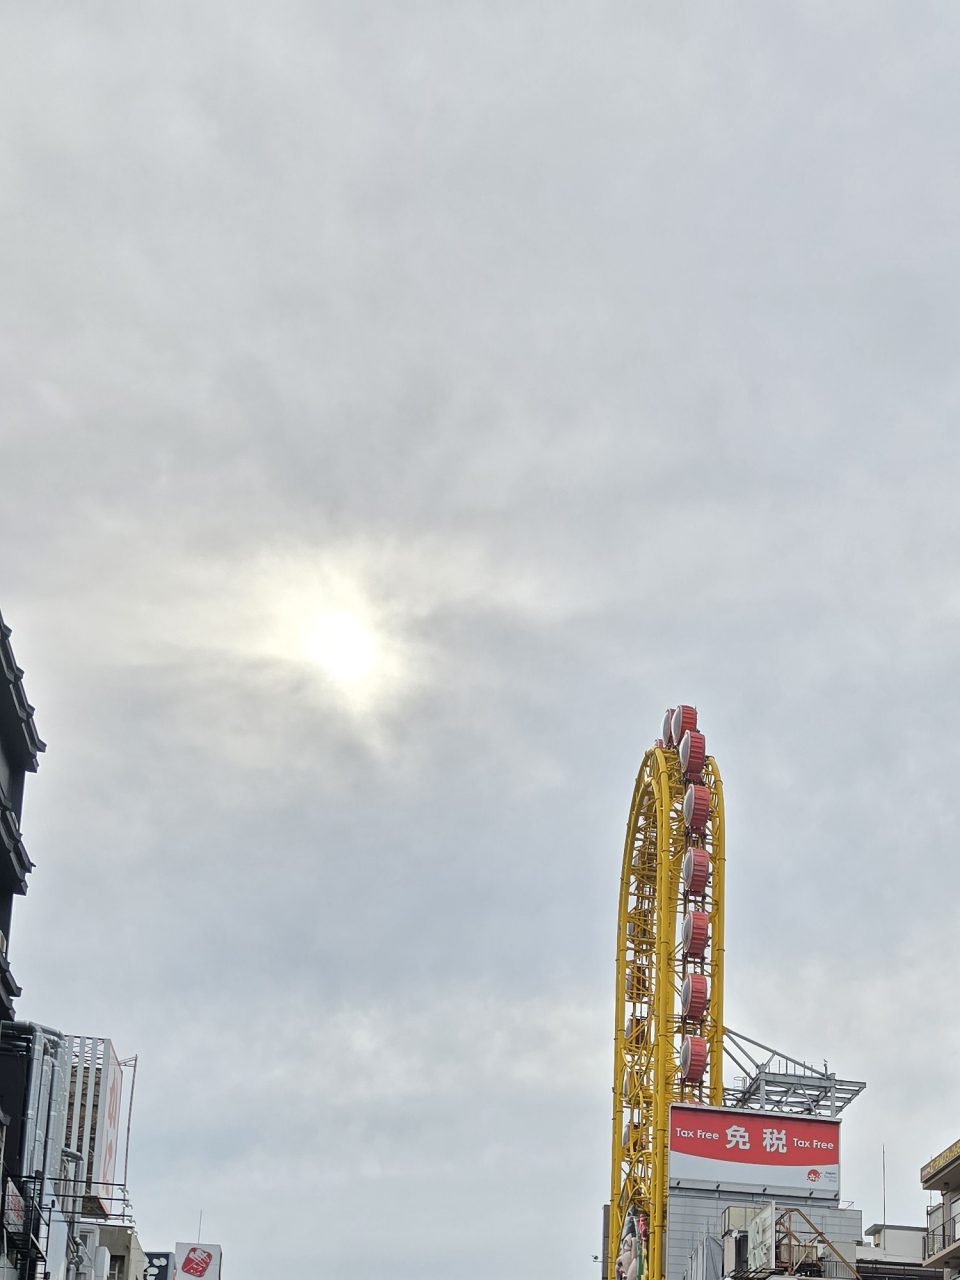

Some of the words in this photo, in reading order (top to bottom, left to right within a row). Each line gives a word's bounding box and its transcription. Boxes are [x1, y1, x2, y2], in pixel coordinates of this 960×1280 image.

[676, 1127, 694, 1138] Tax
[697, 1130, 720, 1140] Free
[792, 1138, 810, 1149] Tax
[813, 1140, 834, 1150] Free
